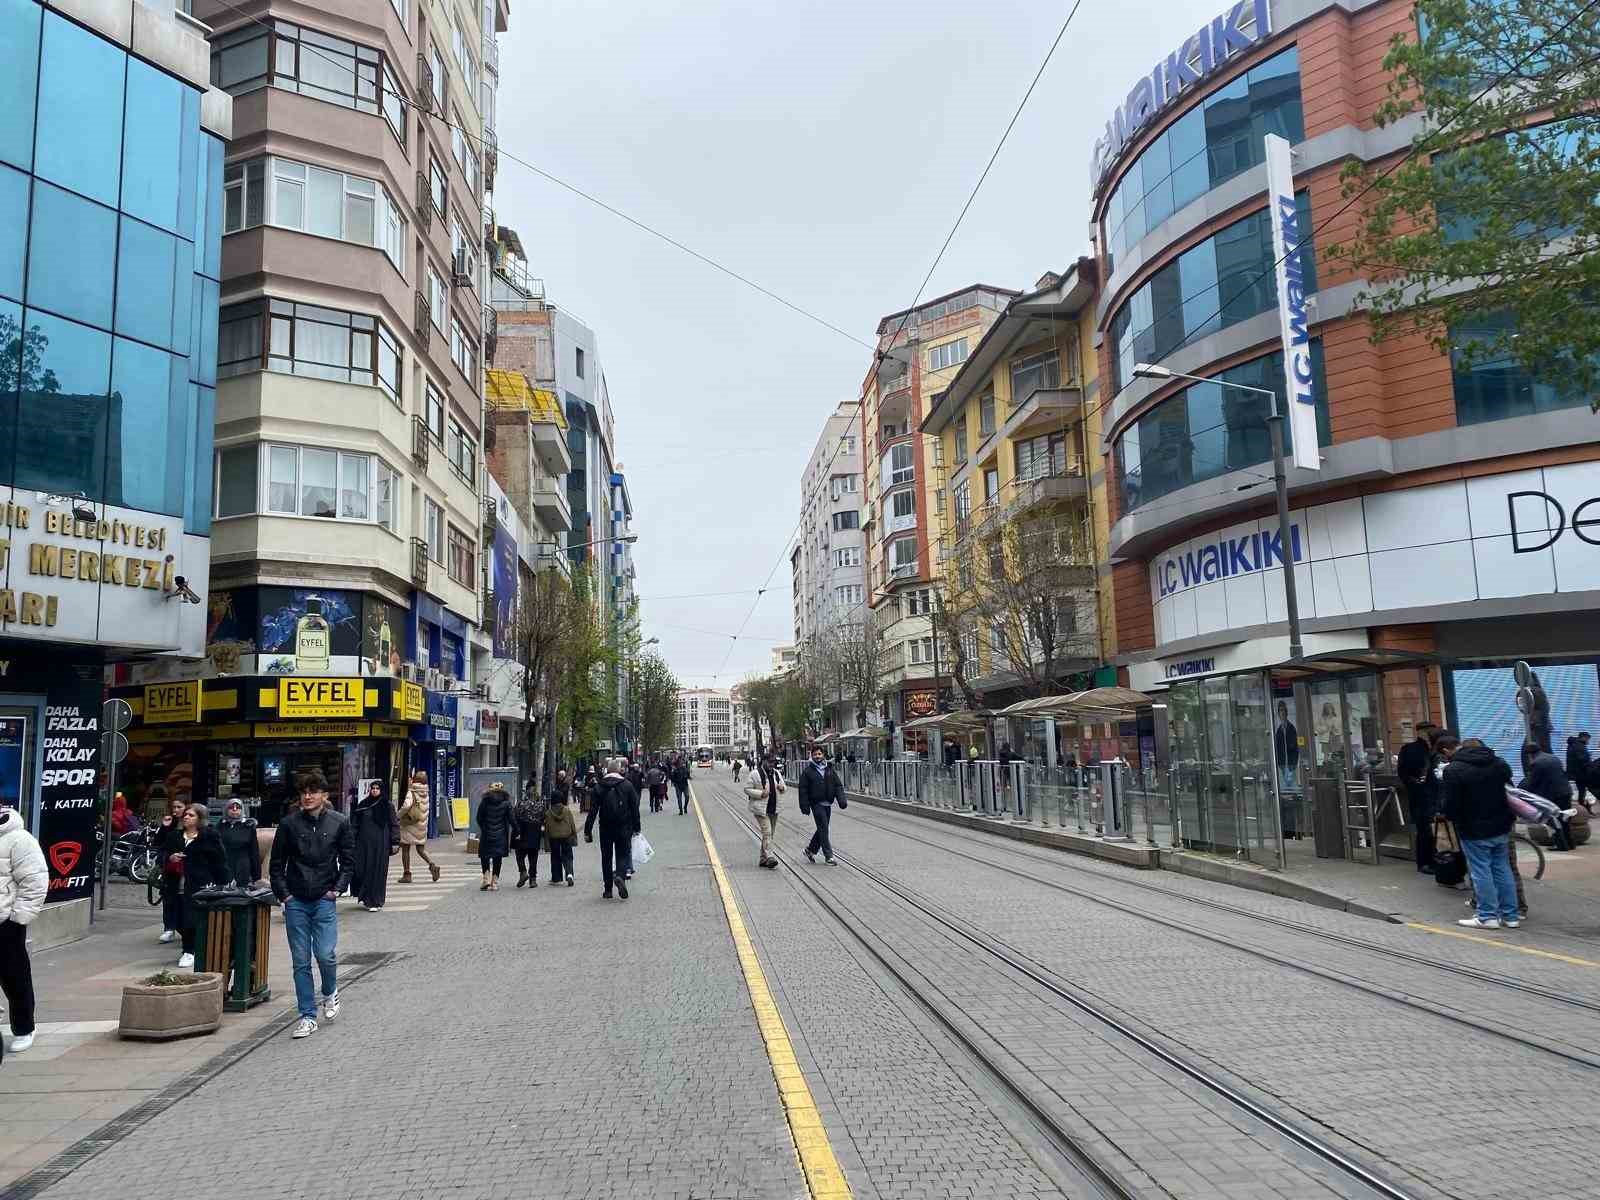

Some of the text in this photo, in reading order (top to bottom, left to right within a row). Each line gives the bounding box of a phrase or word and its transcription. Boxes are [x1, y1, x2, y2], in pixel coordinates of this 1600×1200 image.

[1294, 352, 1315, 406] LC
[0, 501, 167, 551] İR BELEDİYESİ
[30, 542, 176, 593] MERKEZİ
[1158, 559, 1177, 597] LC
[300, 638, 325, 647] EYFEL
[1165, 664, 1176, 679] LC
[148, 686, 192, 709] EYFEL
[286, 681, 356, 702] EYFEL
[406, 686, 421, 706] EYFEL
[45, 706, 80, 717] DAHA
[48, 717, 98, 731] FAZLA
[43, 737, 78, 748] DAHA
[46, 748, 96, 762] KOLAY
[40, 768, 96, 787] SPOR
